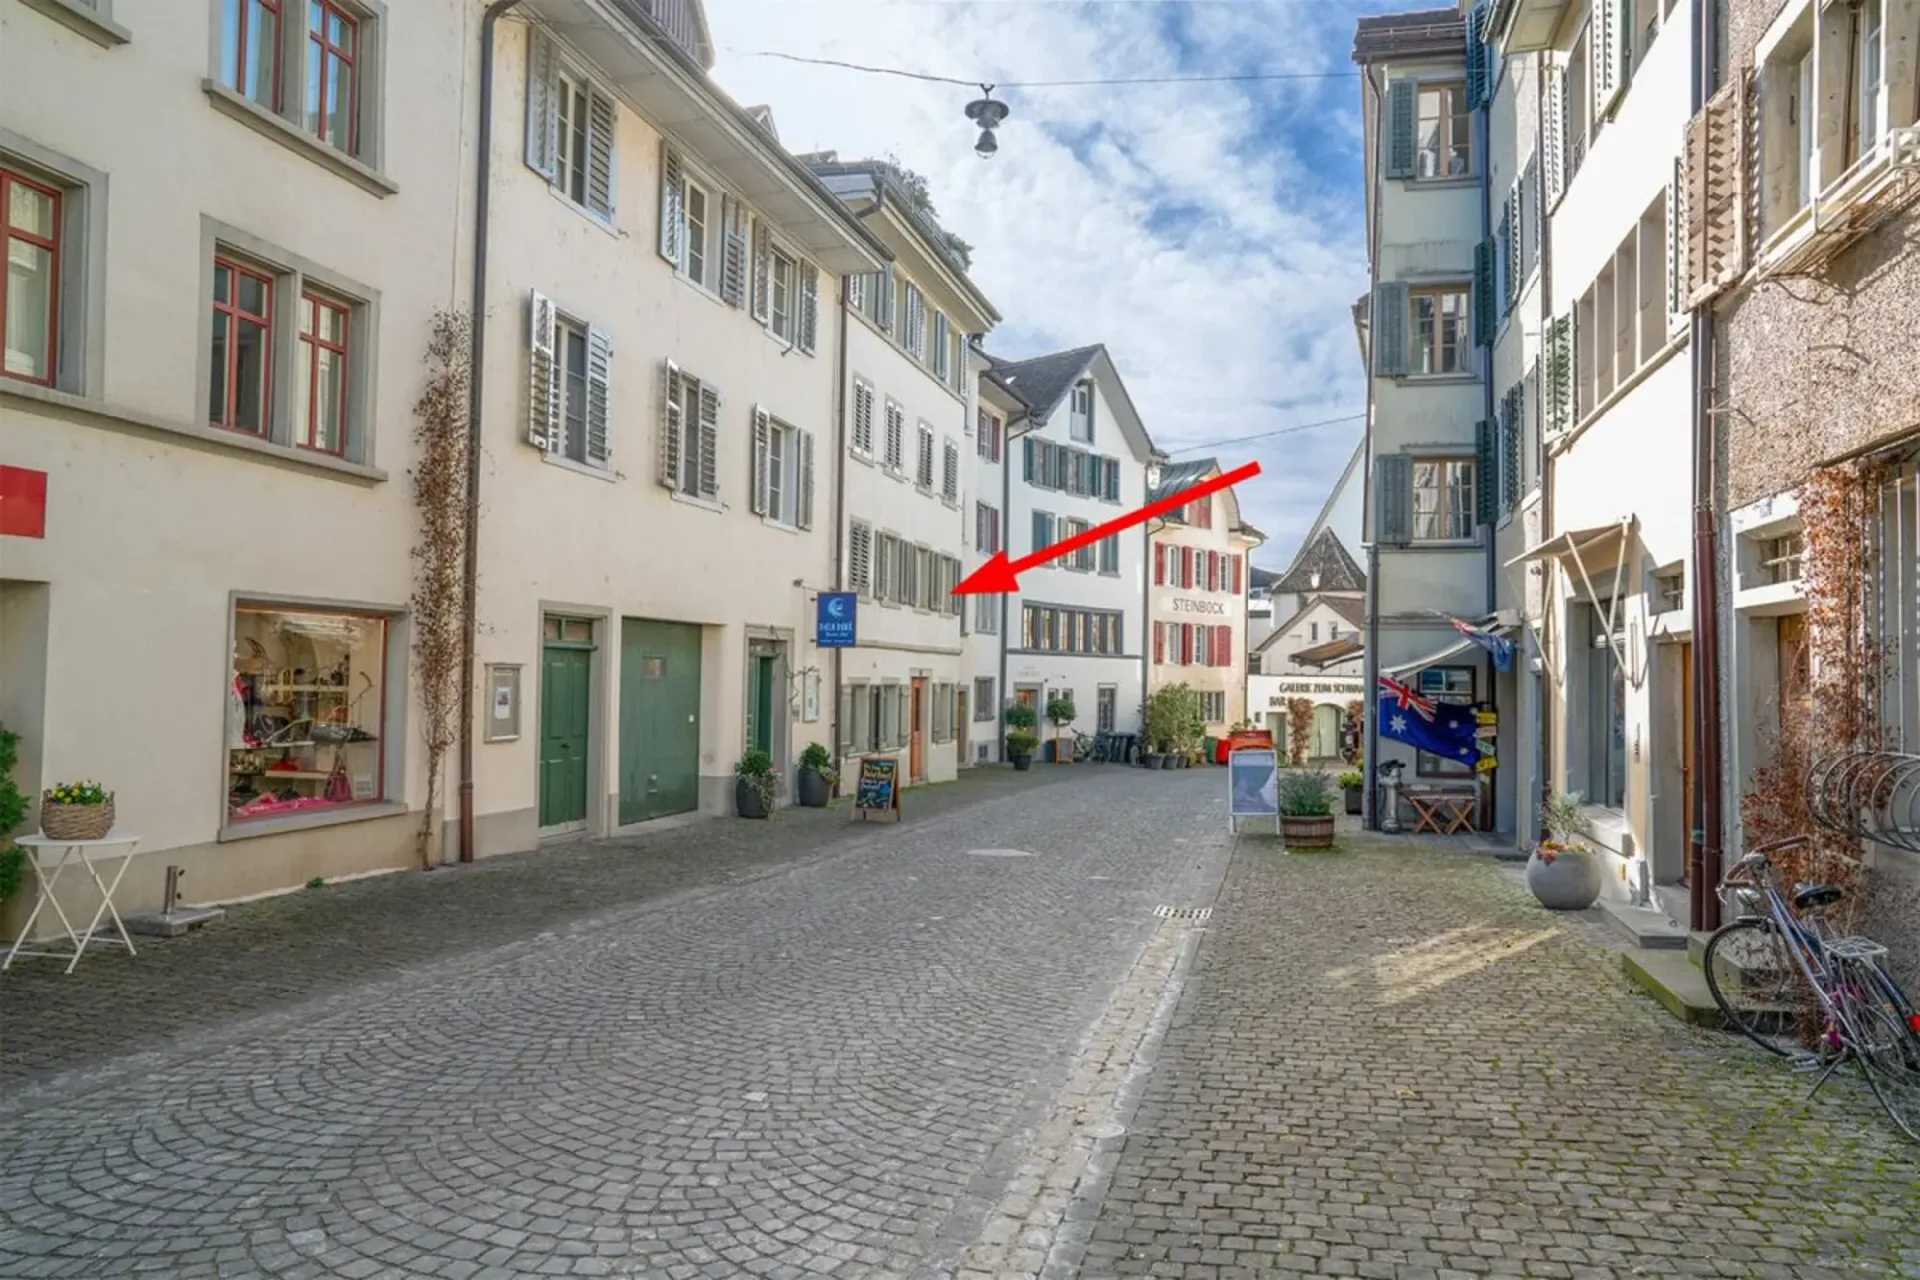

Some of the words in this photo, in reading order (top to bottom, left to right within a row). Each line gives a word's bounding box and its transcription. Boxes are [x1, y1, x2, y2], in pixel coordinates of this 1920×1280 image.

[1172, 598, 1224, 614] STEINBOCK
[1279, 682, 1312, 693] GALERIE
[1314, 683, 1332, 693] ZUM
